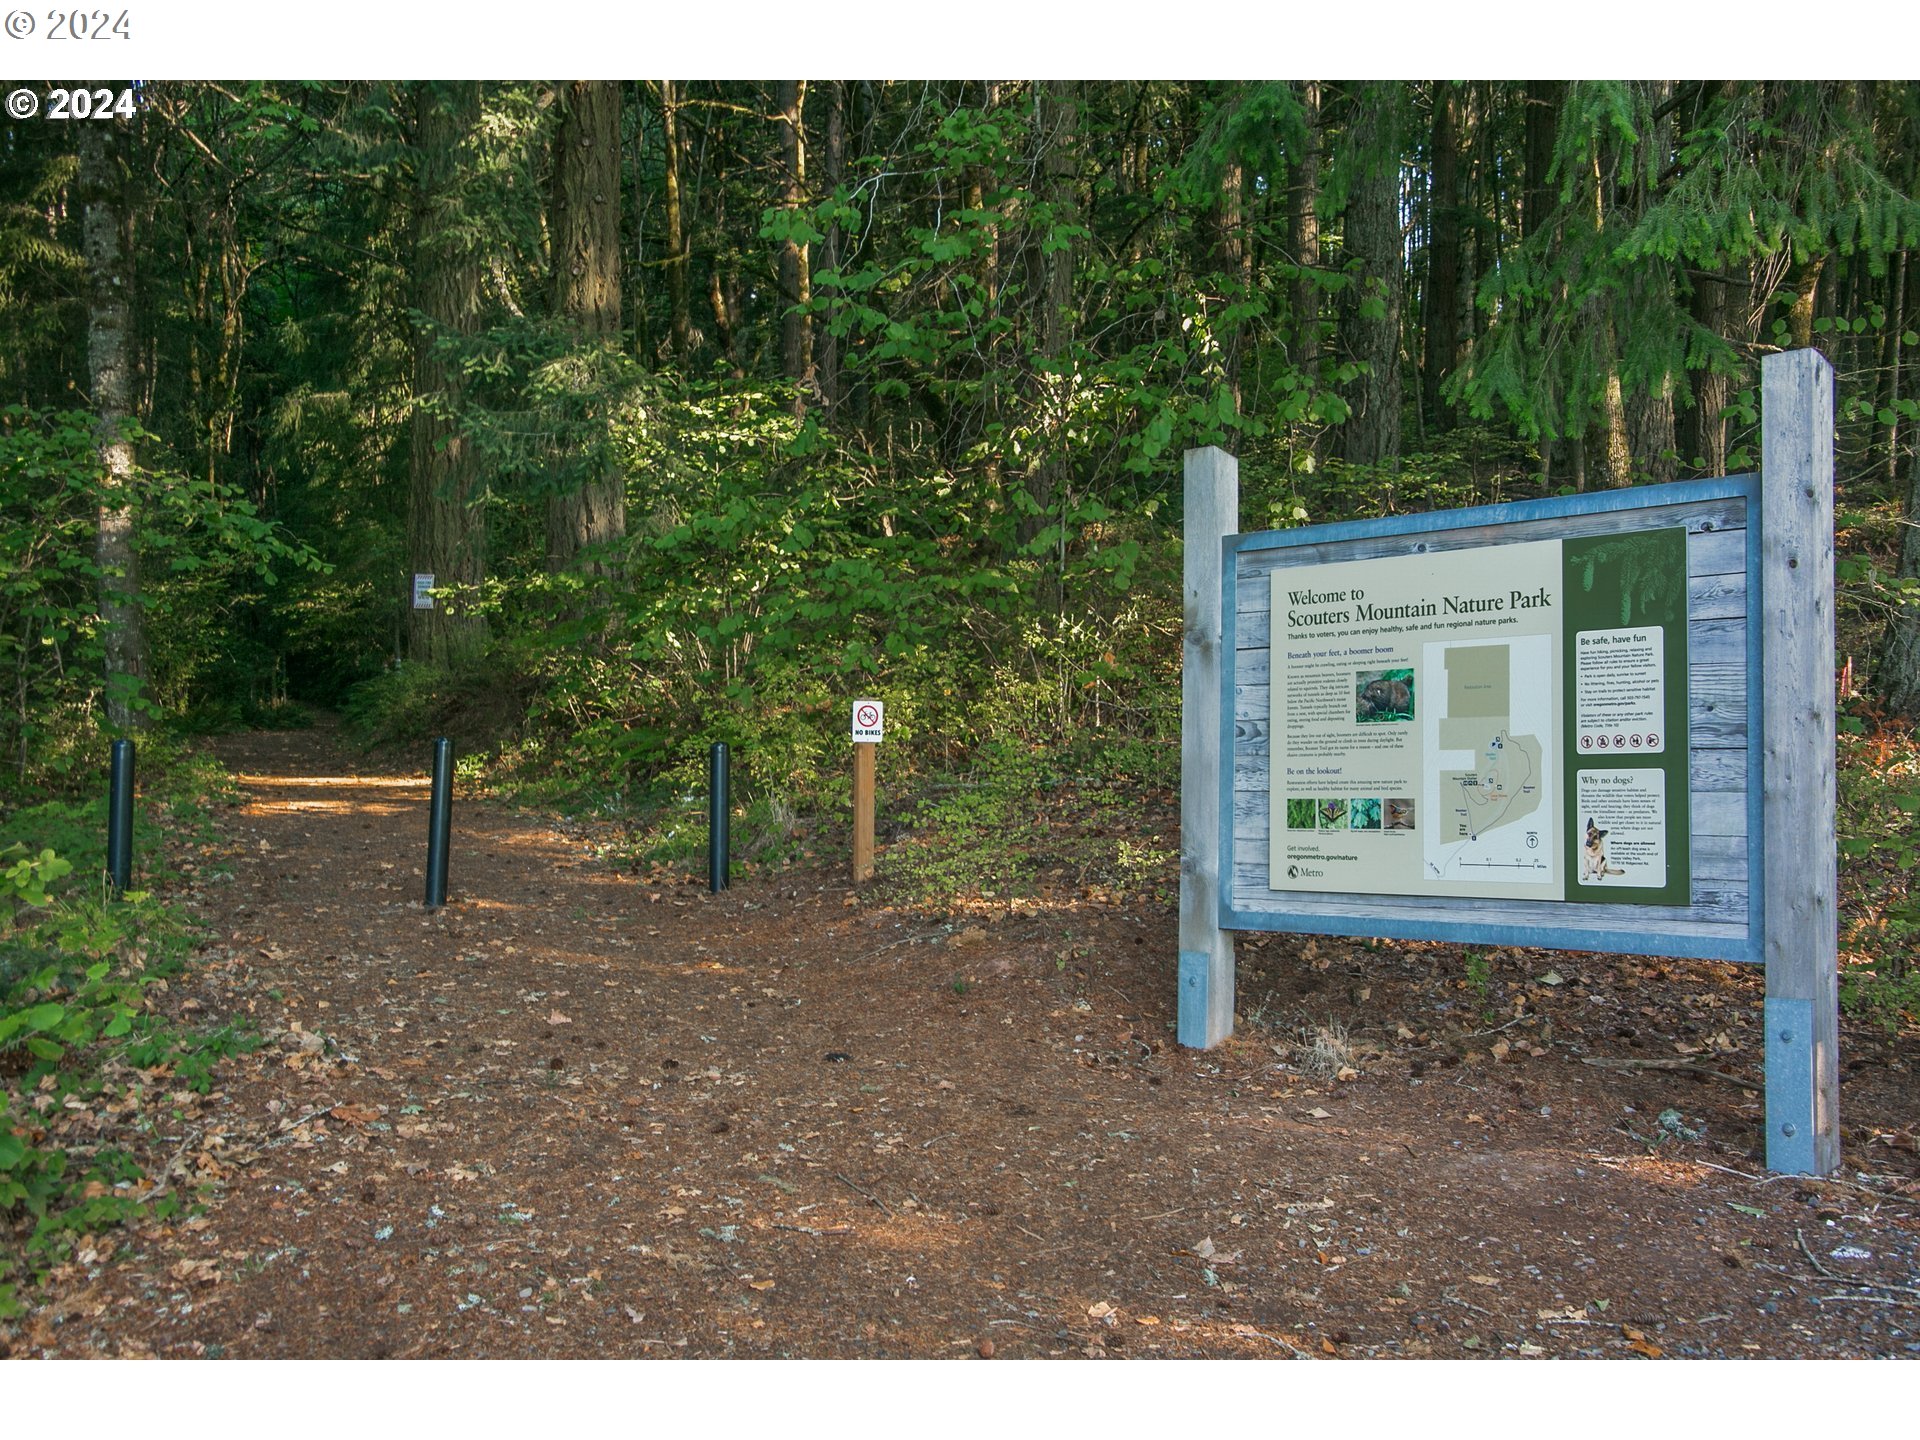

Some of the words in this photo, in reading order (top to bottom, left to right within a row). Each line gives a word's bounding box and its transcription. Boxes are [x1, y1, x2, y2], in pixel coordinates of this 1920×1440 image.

[1288, 589, 1346, 605] Welcome
[1351, 589, 1364, 600] to
[1288, 610, 1350, 627] Scouters
[1356, 599, 1437, 621] Mountain
[1443, 596, 1504, 614] Nature
[1509, 587, 1551, 609] Park
[1362, 627, 1378, 635] enjoy
[1380, 625, 1404, 634] healthy,
[1446, 620, 1473, 629] regional
[1498, 617, 1518, 626] parks.
[1592, 636, 1610, 645] safe,
[1288, 651, 1311, 659] Beneath
[1313, 650, 1326, 659] your
[1581, 776, 1598, 786] Why
[1613, 776, 1634, 785] dogs?
[1300, 868, 1324, 877] Metro
